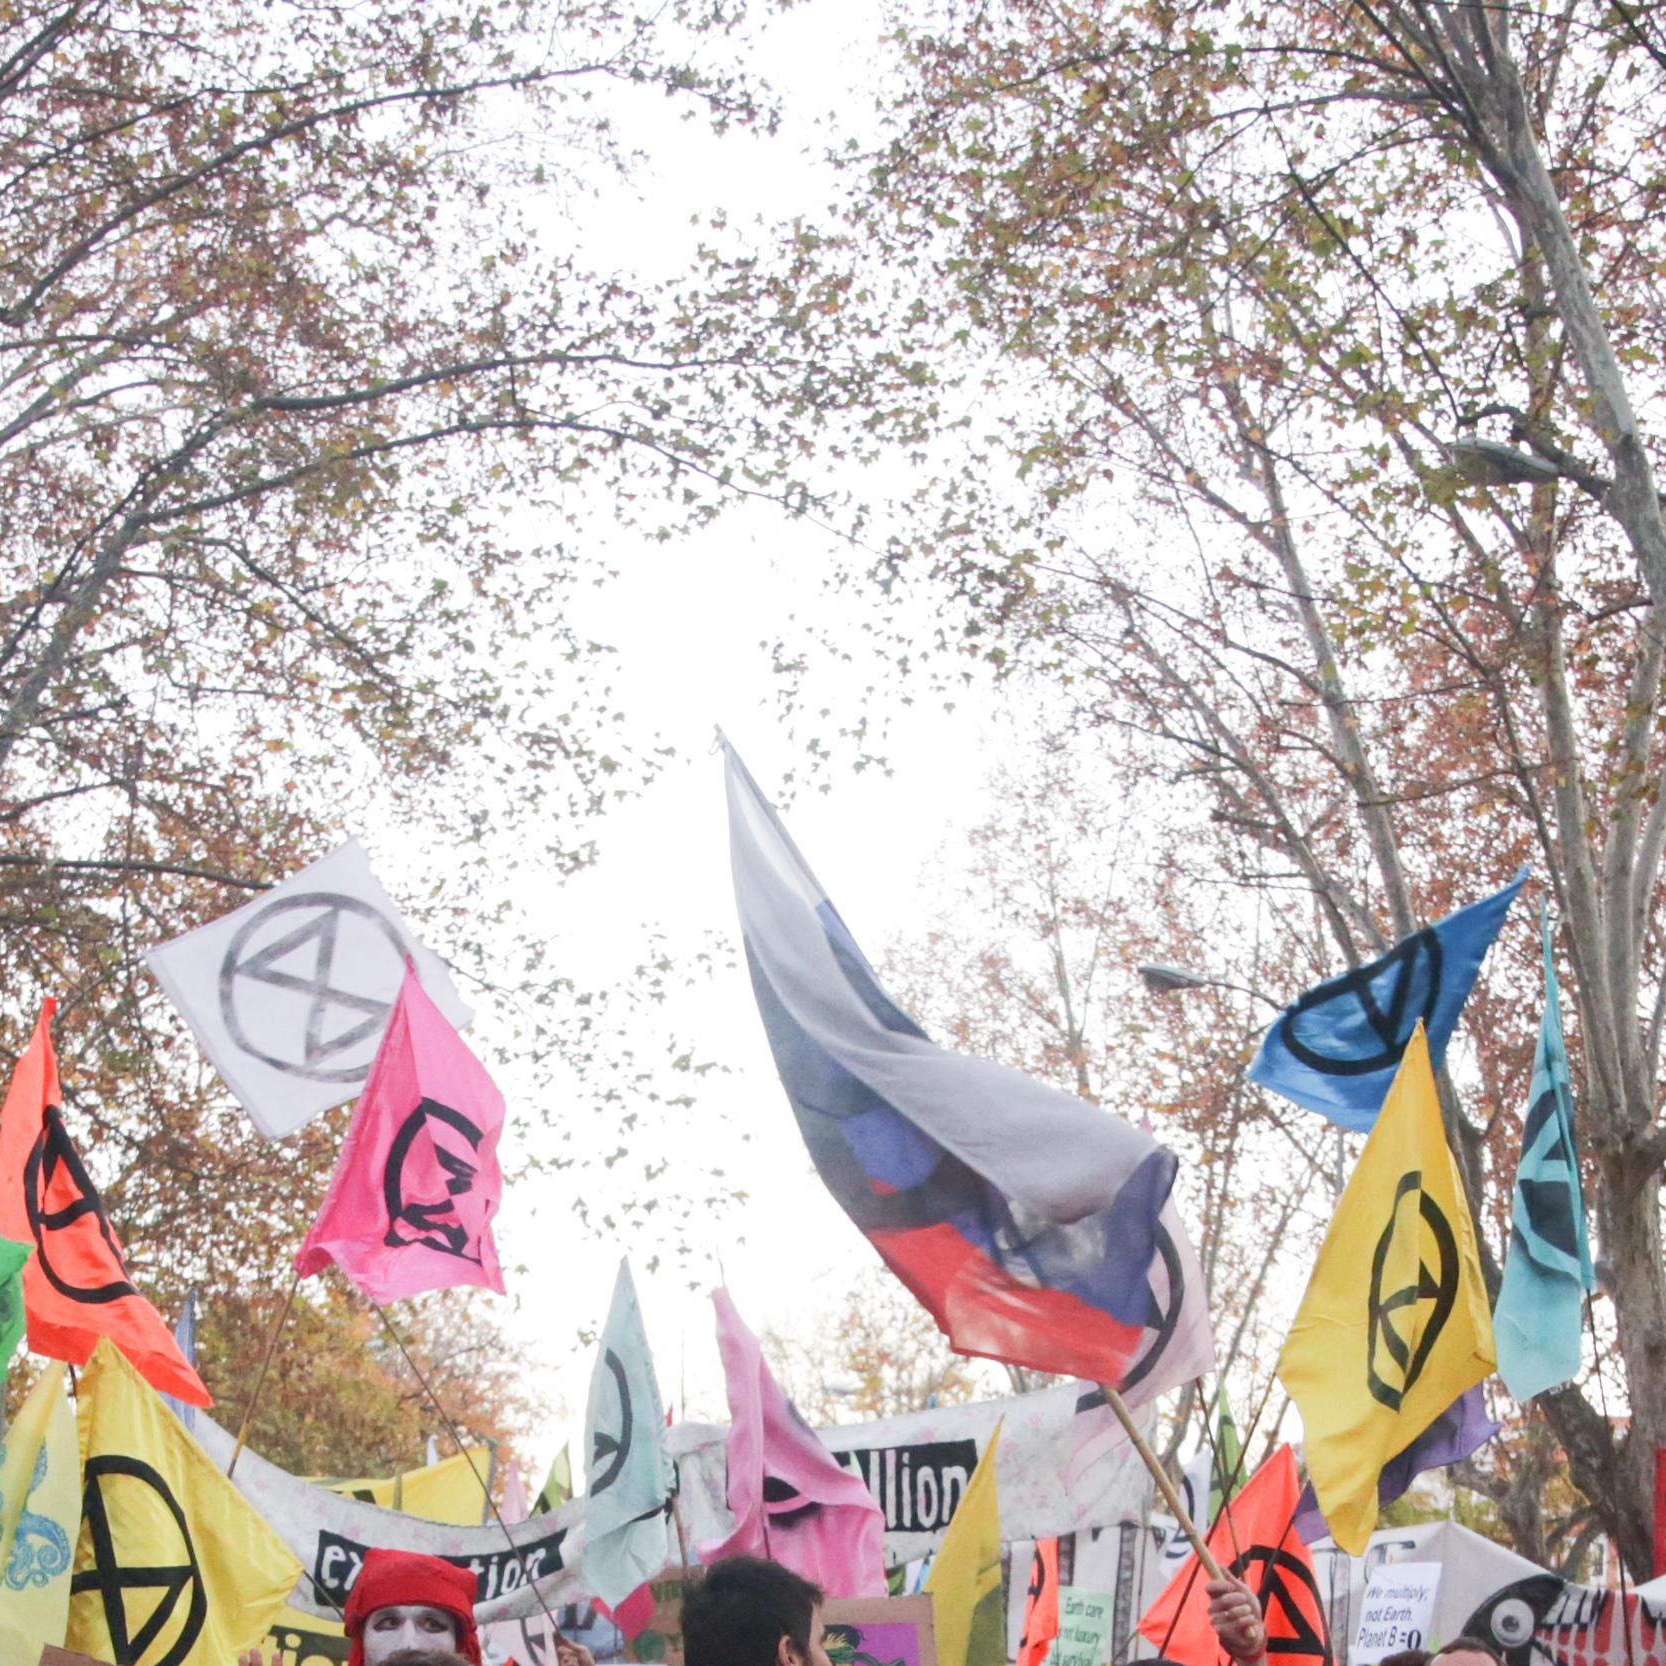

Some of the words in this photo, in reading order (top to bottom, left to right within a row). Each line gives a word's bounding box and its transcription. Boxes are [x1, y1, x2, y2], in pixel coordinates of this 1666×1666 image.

[1364, 1608, 1382, 1623] not
[1358, 1627, 1388, 1649] Planet
[1387, 1625, 1398, 1648] B
